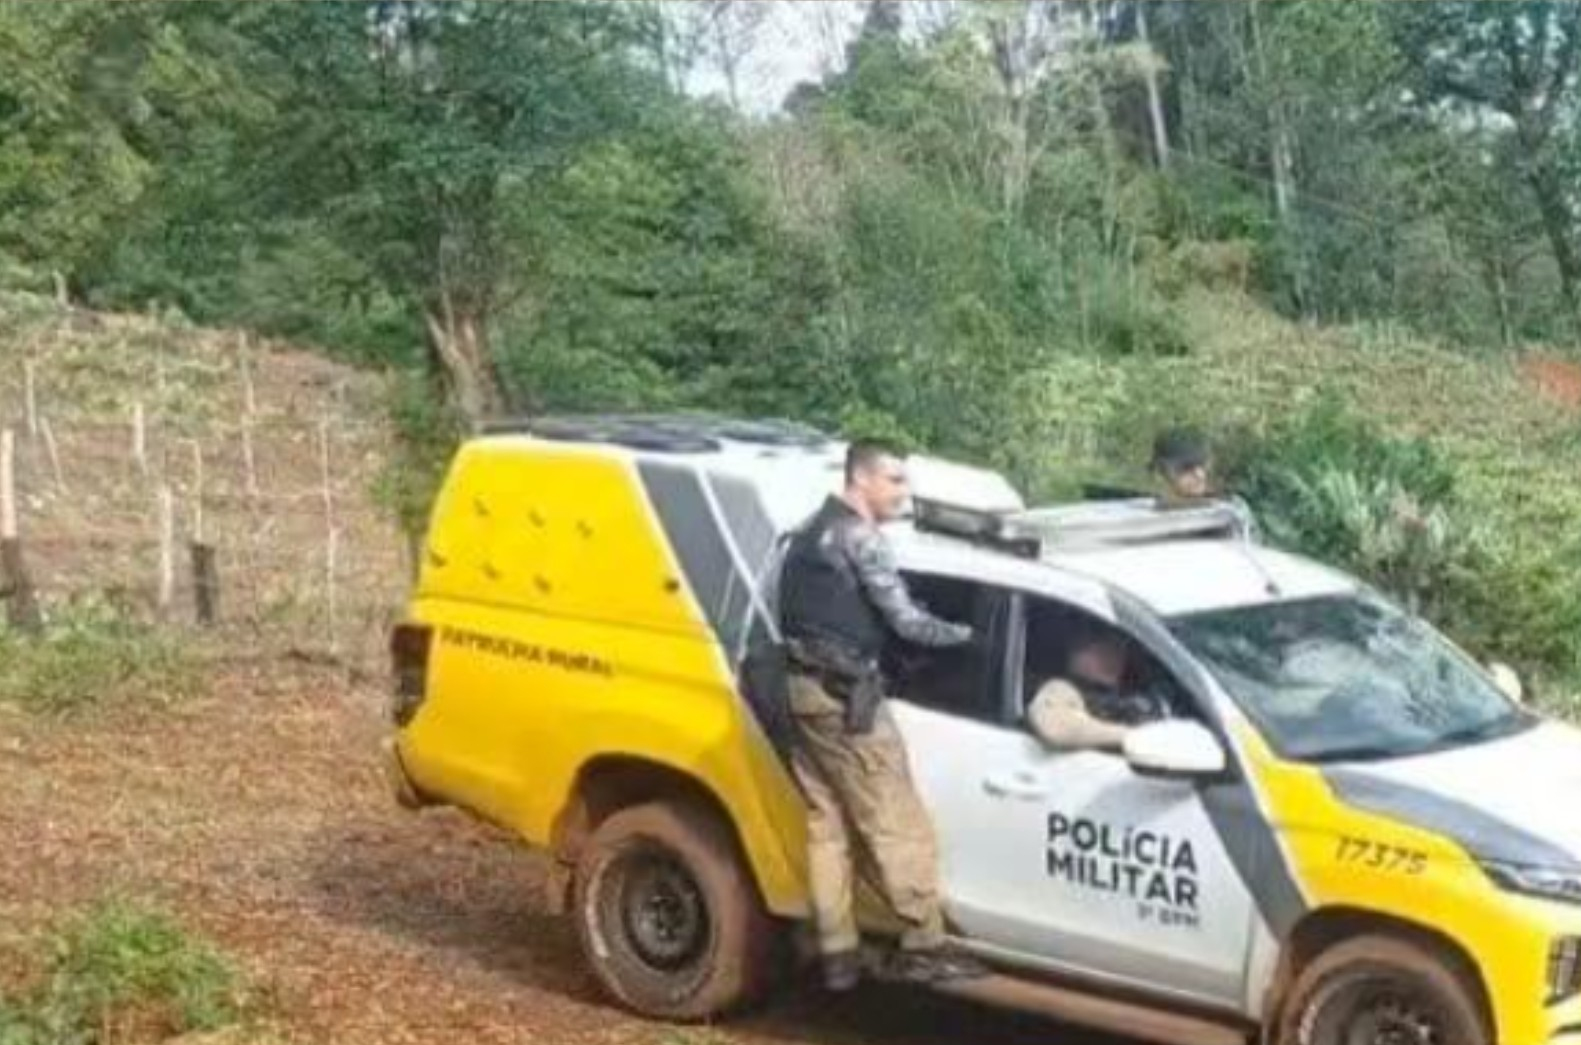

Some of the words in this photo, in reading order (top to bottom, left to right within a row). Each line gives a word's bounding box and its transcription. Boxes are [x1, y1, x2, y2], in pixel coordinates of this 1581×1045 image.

[545, 647, 613, 677] RURAL
[1047, 811, 1197, 874] POLÍCIA
[1335, 835, 1428, 875] 17375
[1047, 849, 1198, 910] MILITAR
